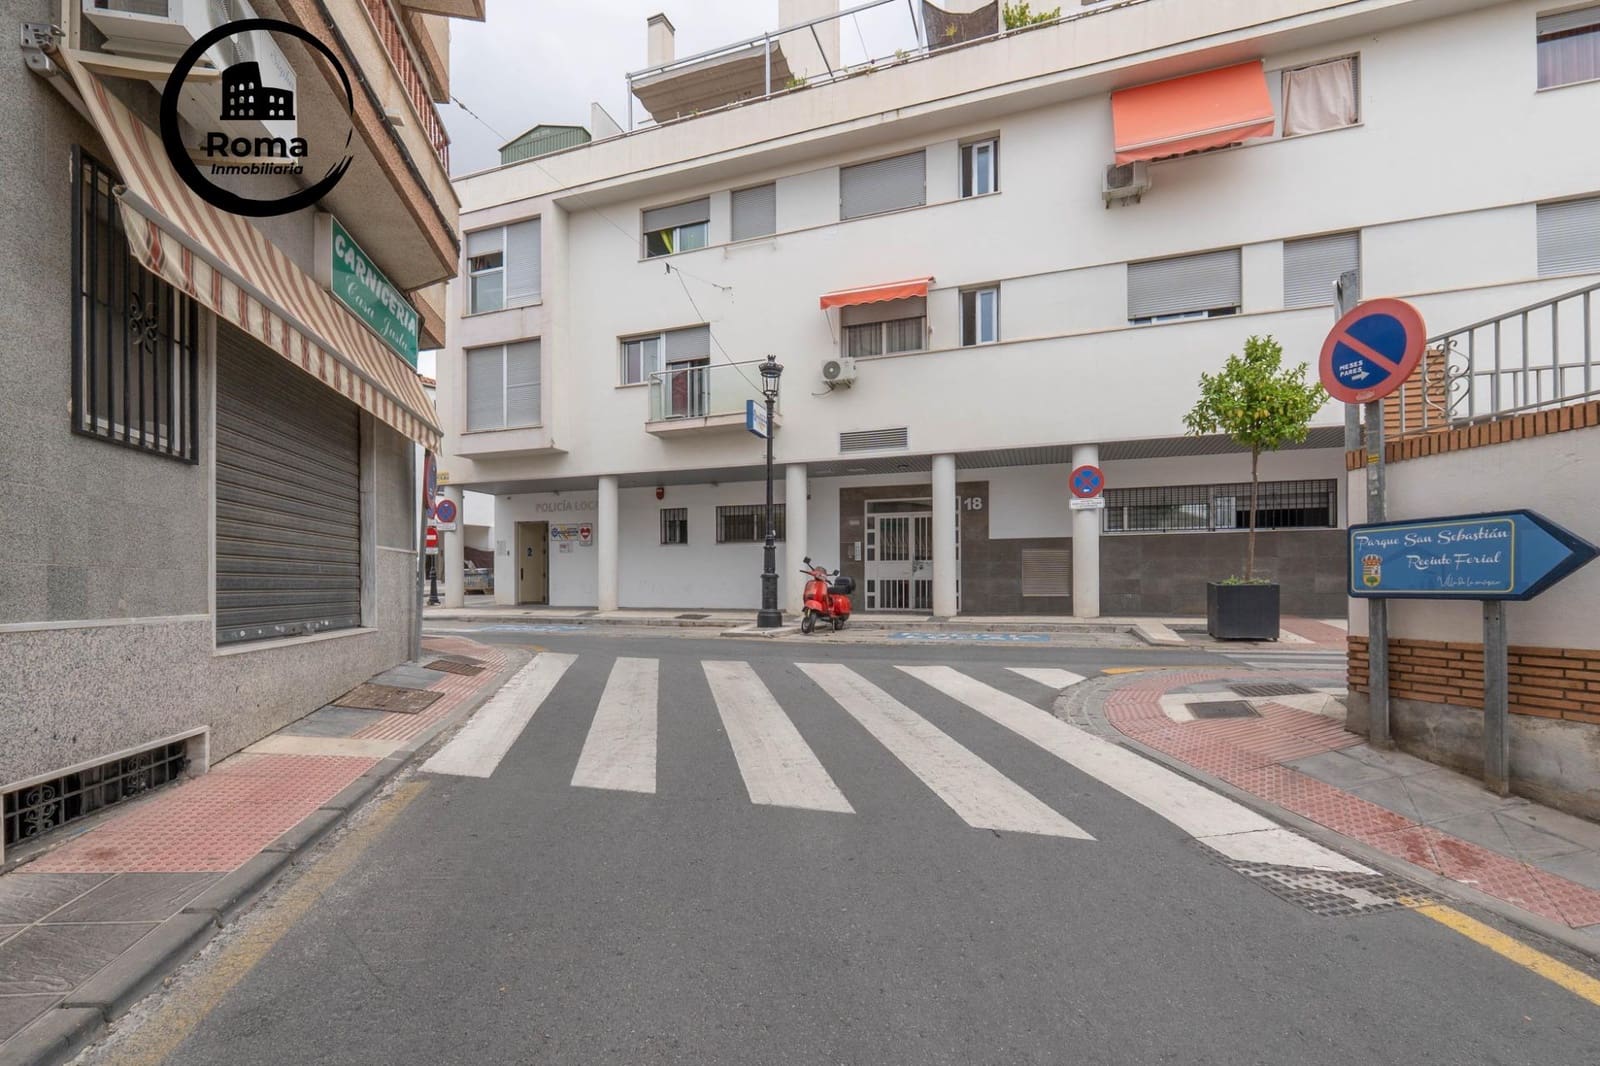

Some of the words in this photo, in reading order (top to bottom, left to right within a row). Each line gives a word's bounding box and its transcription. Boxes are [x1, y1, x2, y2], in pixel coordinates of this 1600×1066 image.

[335, 234, 416, 337] CARNICERIA
[1339, 359, 1363, 371] MESES
[1340, 366, 1362, 378] PARES
[536, 500, 572, 512] POLICÍA
[575, 500, 599, 512] LOC
[964, 497, 983, 511] 18
[1356, 536, 1400, 551] Parque
[1404, 532, 1432, 547] San
[1437, 527, 1508, 544] Sebastián
[1406, 554, 1451, 570] Recinto
[1453, 551, 1502, 570] Ferial
